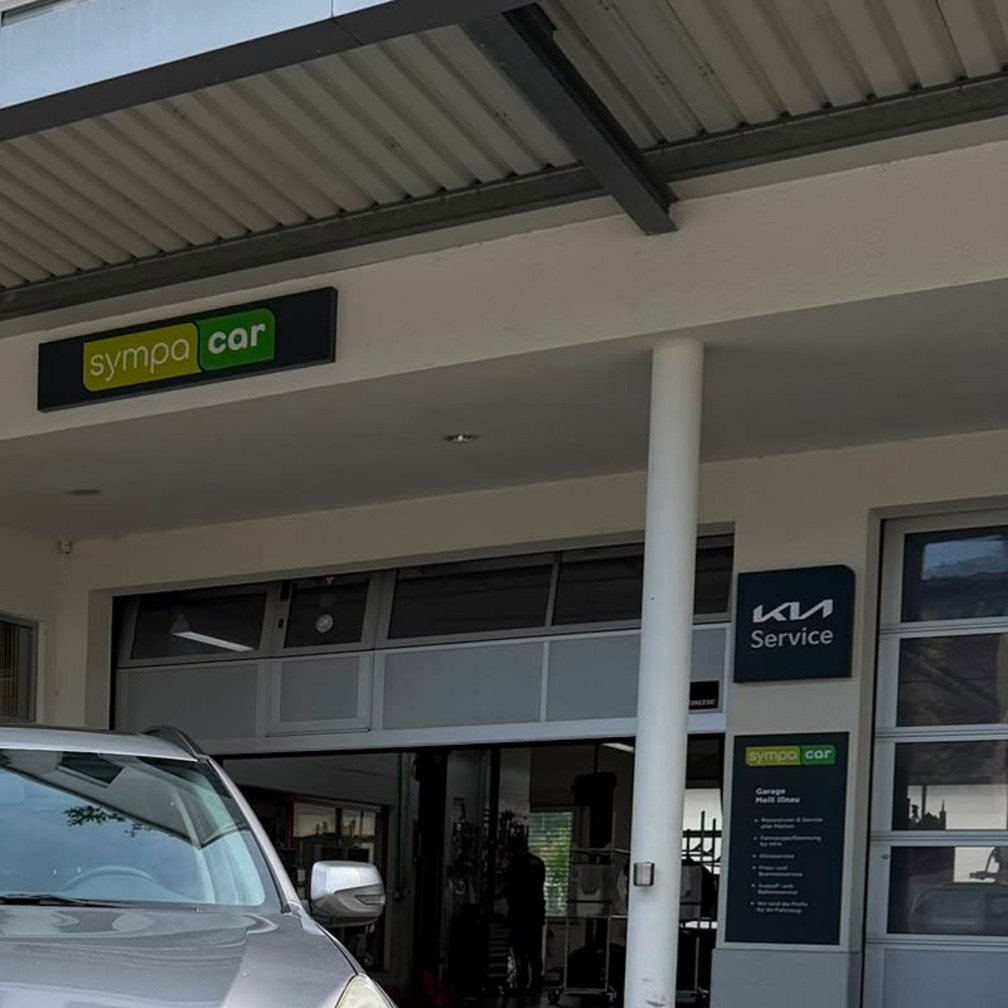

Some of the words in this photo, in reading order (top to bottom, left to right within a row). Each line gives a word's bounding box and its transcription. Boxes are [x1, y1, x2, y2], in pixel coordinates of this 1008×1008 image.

[90, 338, 190, 382] sympa
[208, 322, 266, 355] car
[753, 599, 833, 623] KIA
[751, 627, 833, 648] Service
[750, 750, 797, 764] sympa
[805, 749, 832, 760] car
[756, 788, 786, 796] Garage
